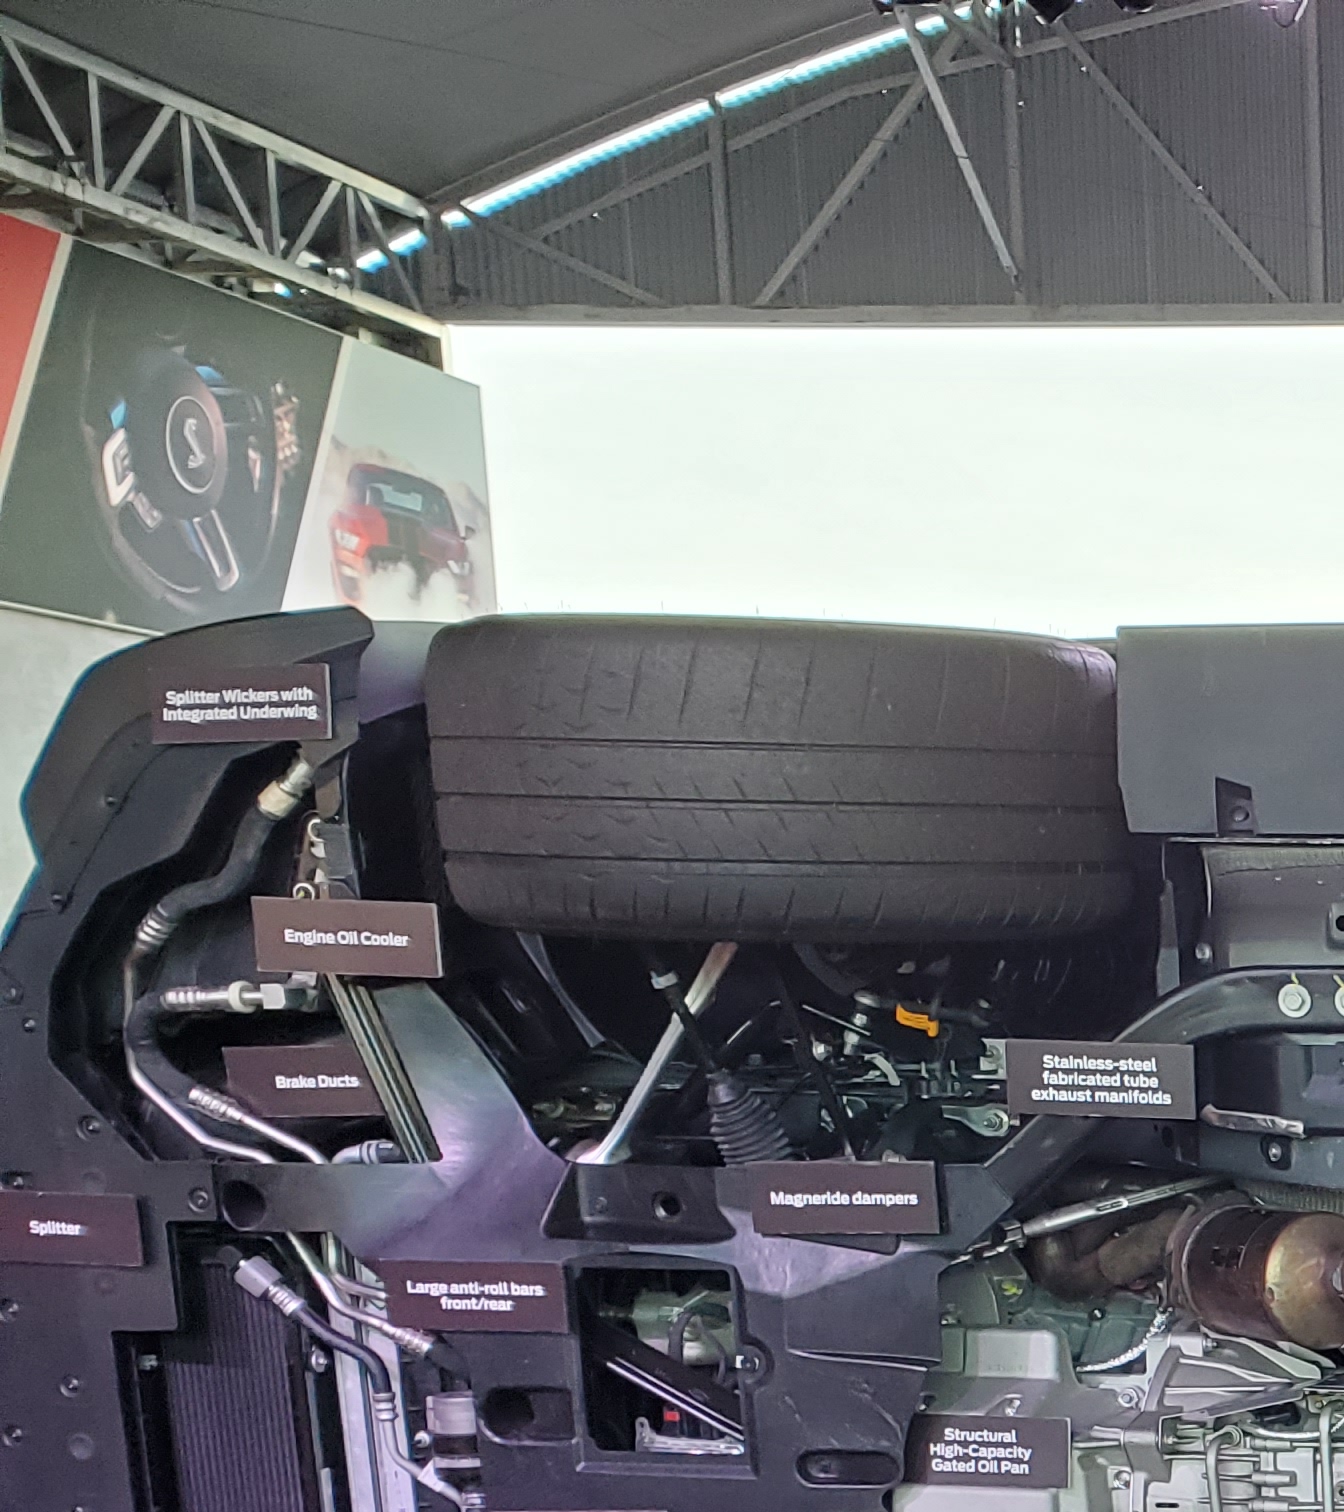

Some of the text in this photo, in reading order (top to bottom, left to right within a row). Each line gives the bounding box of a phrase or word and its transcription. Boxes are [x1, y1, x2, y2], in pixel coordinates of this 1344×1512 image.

[166, 687, 314, 706] Splitter Wickers with
[163, 704, 318, 723] Integrated Underwing
[284, 929, 410, 946] Engine Oil Cooler
[1043, 1055, 1157, 1072] Stainless-steel
[275, 1075, 360, 1088] Brake Ducts
[1042, 1071, 1158, 1088] fabricated tube
[1031, 1087, 1171, 1104] exhaust manifolds
[770, 1191, 918, 1207] Magneride dampers
[30, 1220, 82, 1236] Splitter
[407, 1280, 545, 1296] Large anti-roll bars
[440, 1296, 514, 1311] front/rear
[944, 1428, 1017, 1442] Structural
[930, 1443, 1032, 1460] High-Capacity
[932, 1458, 1029, 1474] Gated Oil Pan
